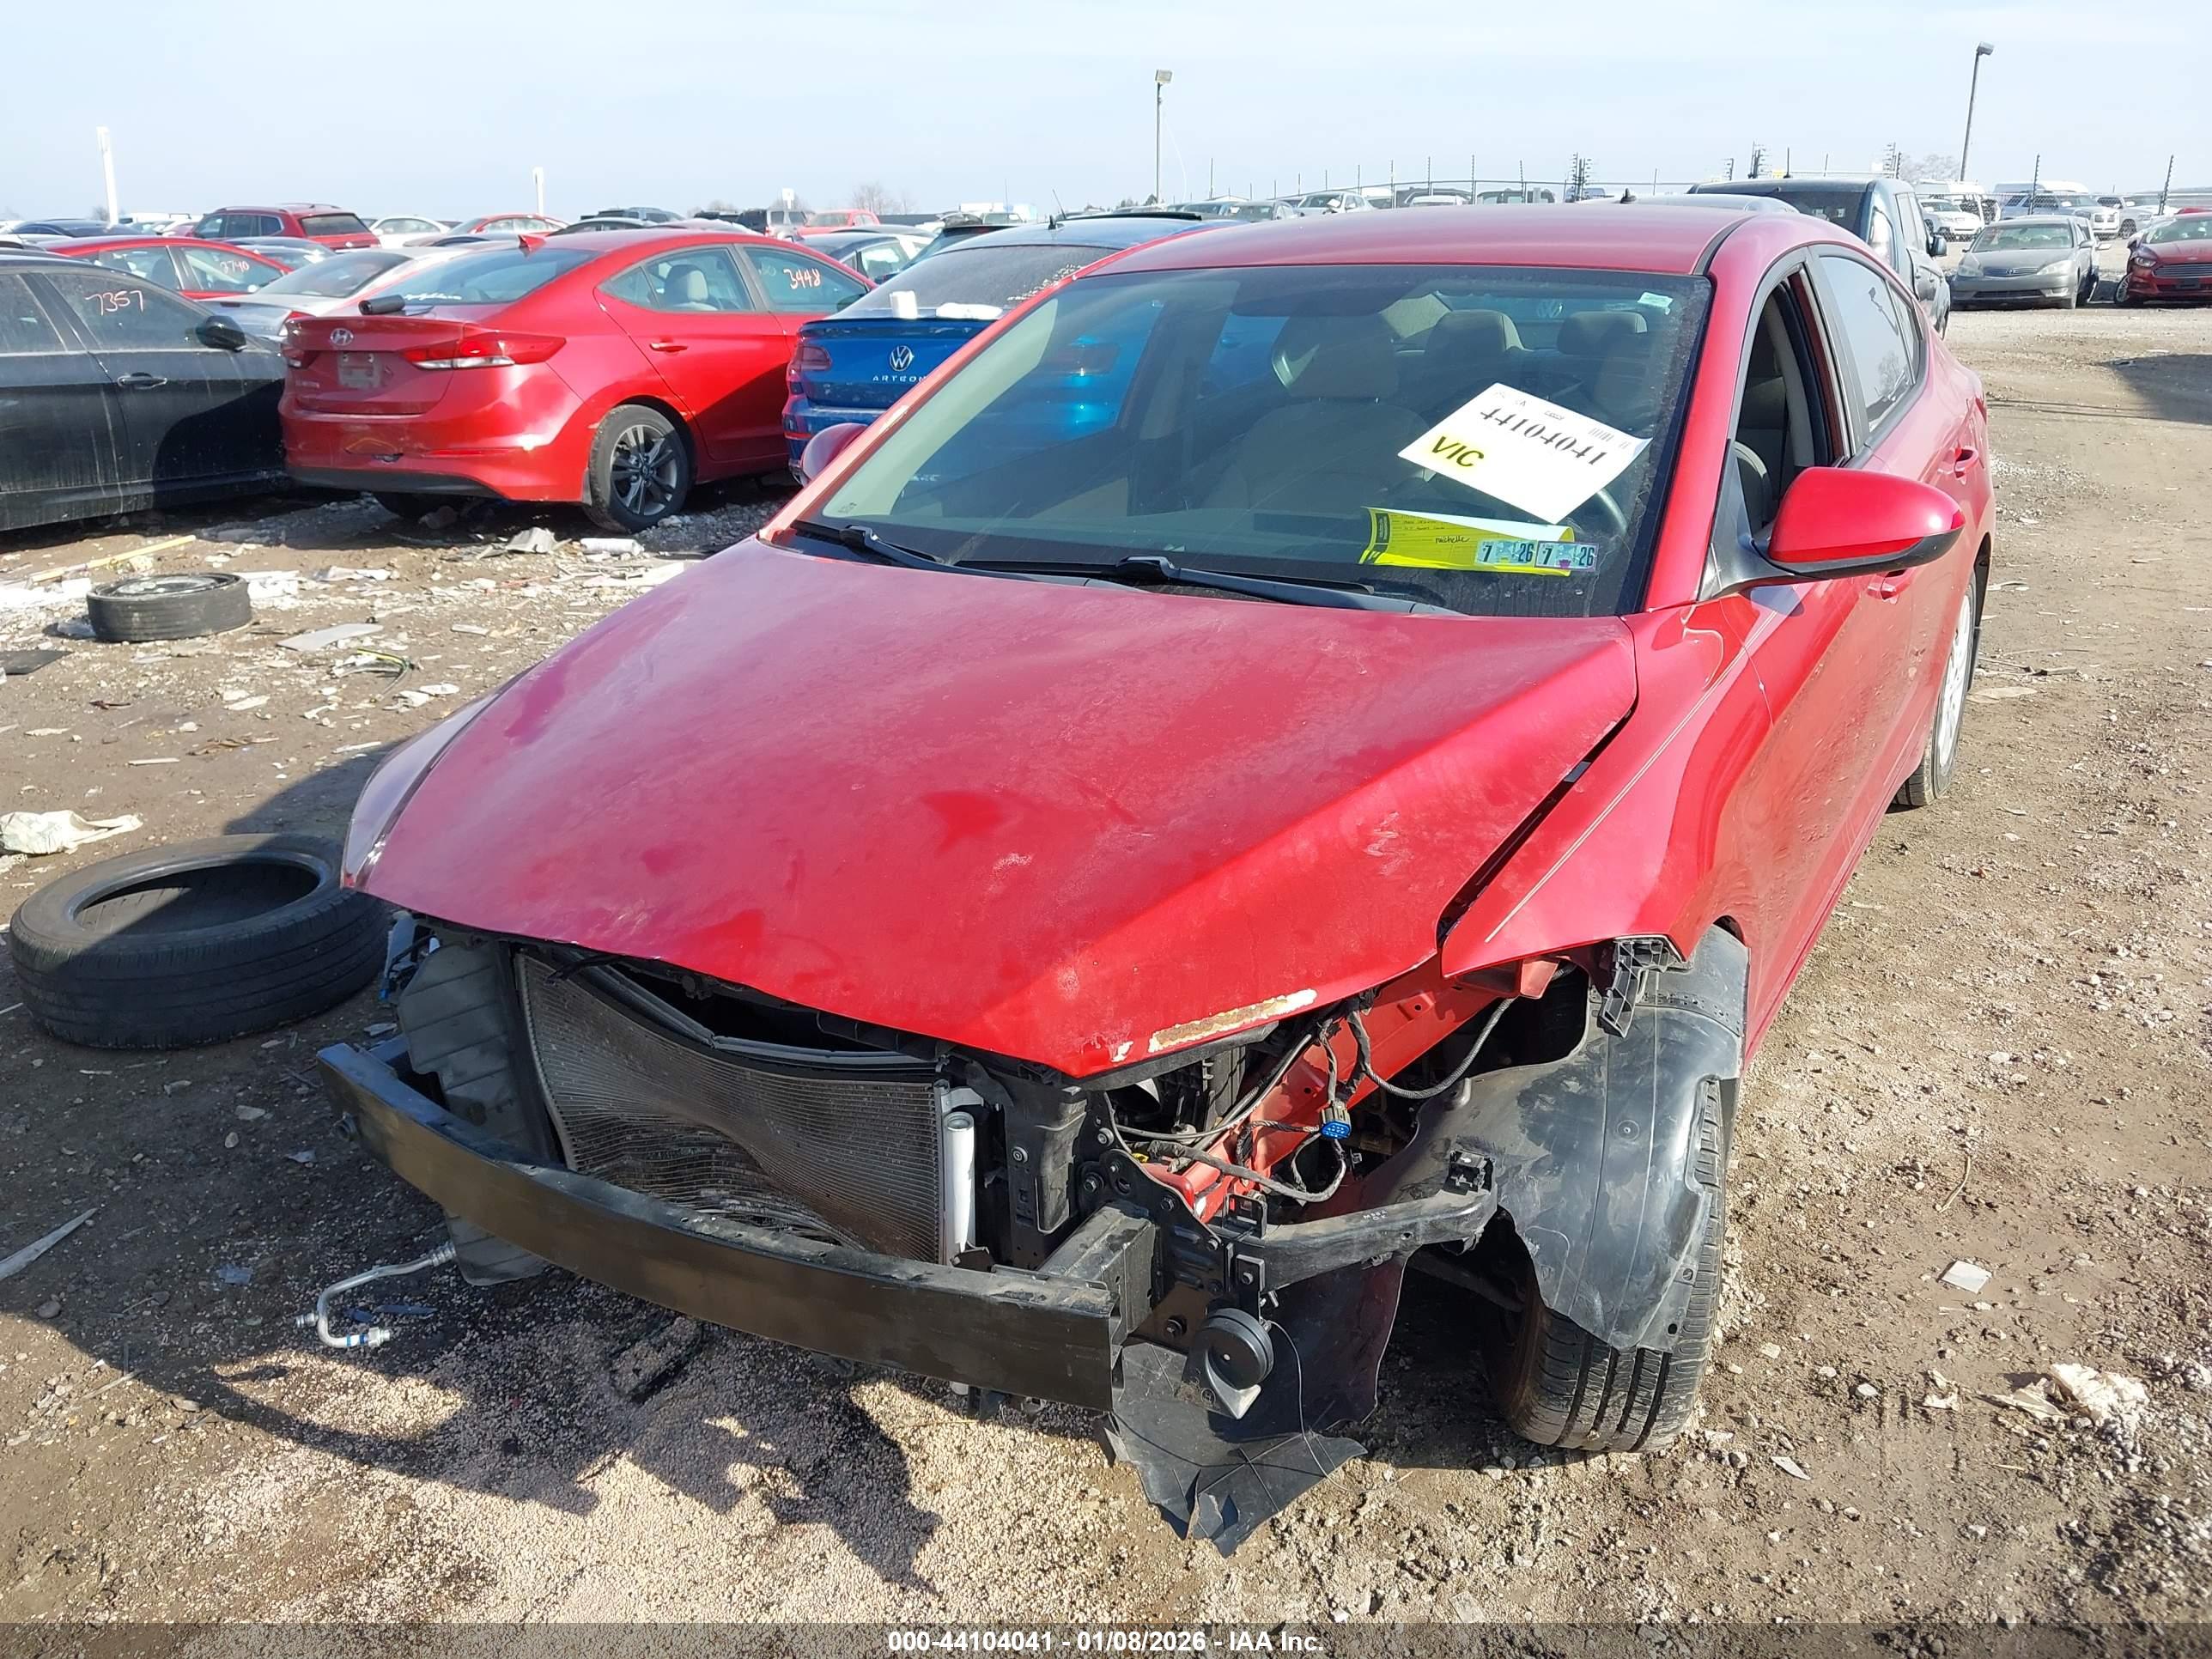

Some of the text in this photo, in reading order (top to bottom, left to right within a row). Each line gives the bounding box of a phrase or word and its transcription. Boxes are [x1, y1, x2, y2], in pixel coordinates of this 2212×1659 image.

[782, 267, 821, 289] 3448
[85, 290, 143, 316] 7357
[1480, 408, 1608, 465] 44104041
[1431, 435, 1485, 467] VIC
[1517, 543, 1534, 562] 26
[1578, 546, 1595, 566] 26
